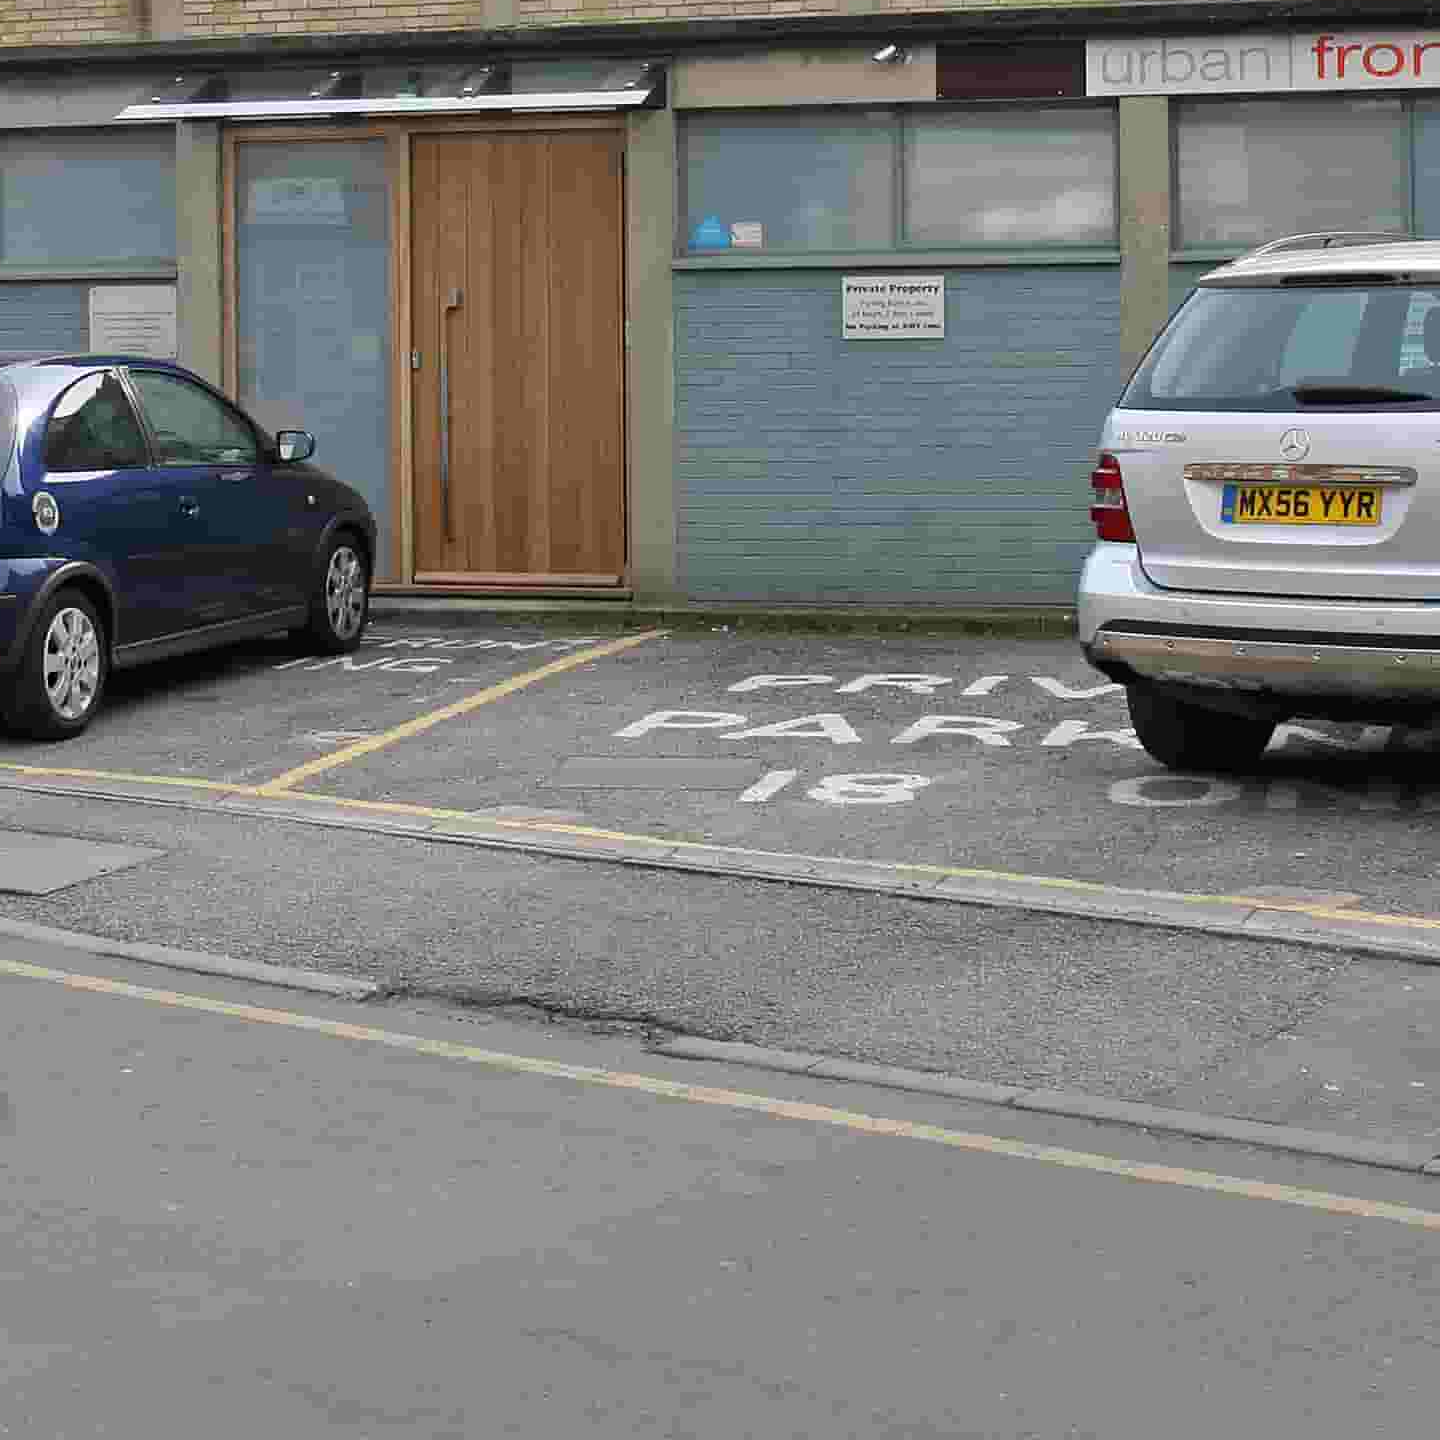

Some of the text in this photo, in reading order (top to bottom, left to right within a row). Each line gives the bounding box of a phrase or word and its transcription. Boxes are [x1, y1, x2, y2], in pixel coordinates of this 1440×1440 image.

[1100, 39, 1272, 84] urban
[889, 283, 940, 297] Property
[1238, 490, 1376, 519] MX56 YYR
[726, 673, 1127, 698] PRIV
[736, 768, 930, 804] 18
